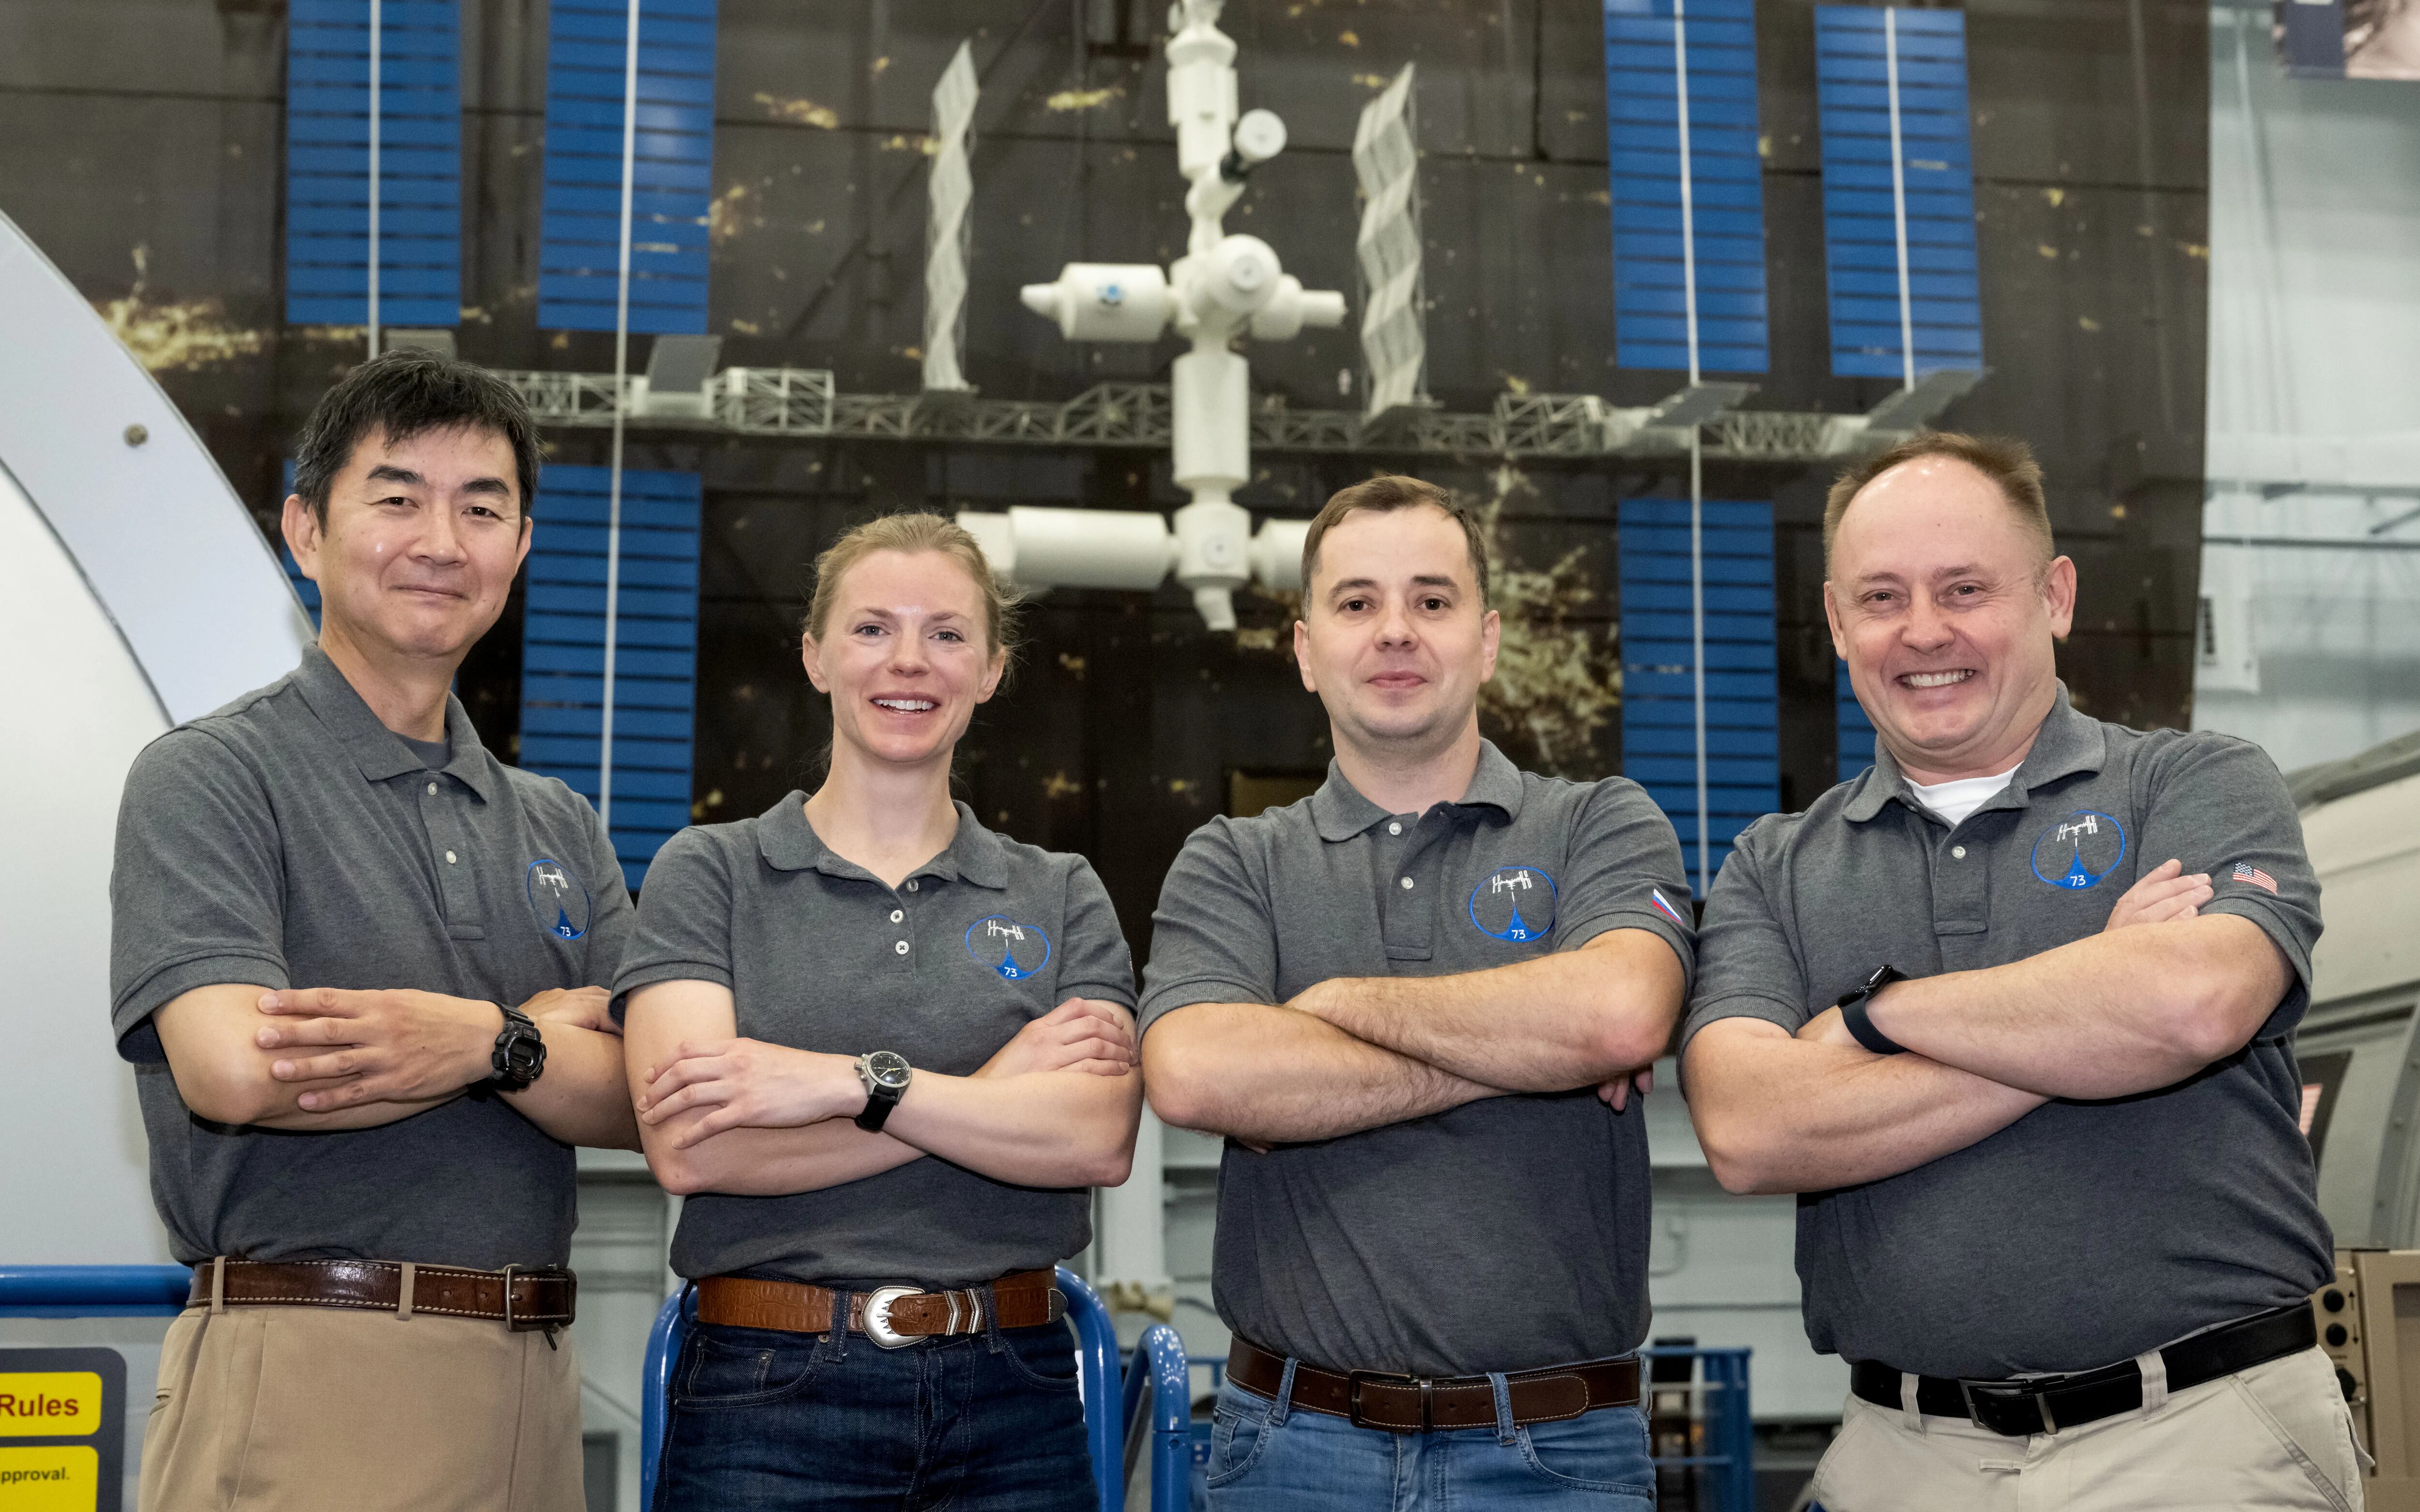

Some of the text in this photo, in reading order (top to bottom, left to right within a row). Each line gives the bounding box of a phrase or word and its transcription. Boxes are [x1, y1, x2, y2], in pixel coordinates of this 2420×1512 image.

[2070, 875, 2086, 886] 73
[560, 926, 571, 937] 73
[1511, 929, 1526, 939] 73
[1004, 967, 1017, 977] 73
[0, 1393, 78, 1417] Rules
[0, 1467, 70, 1485] pproval.
